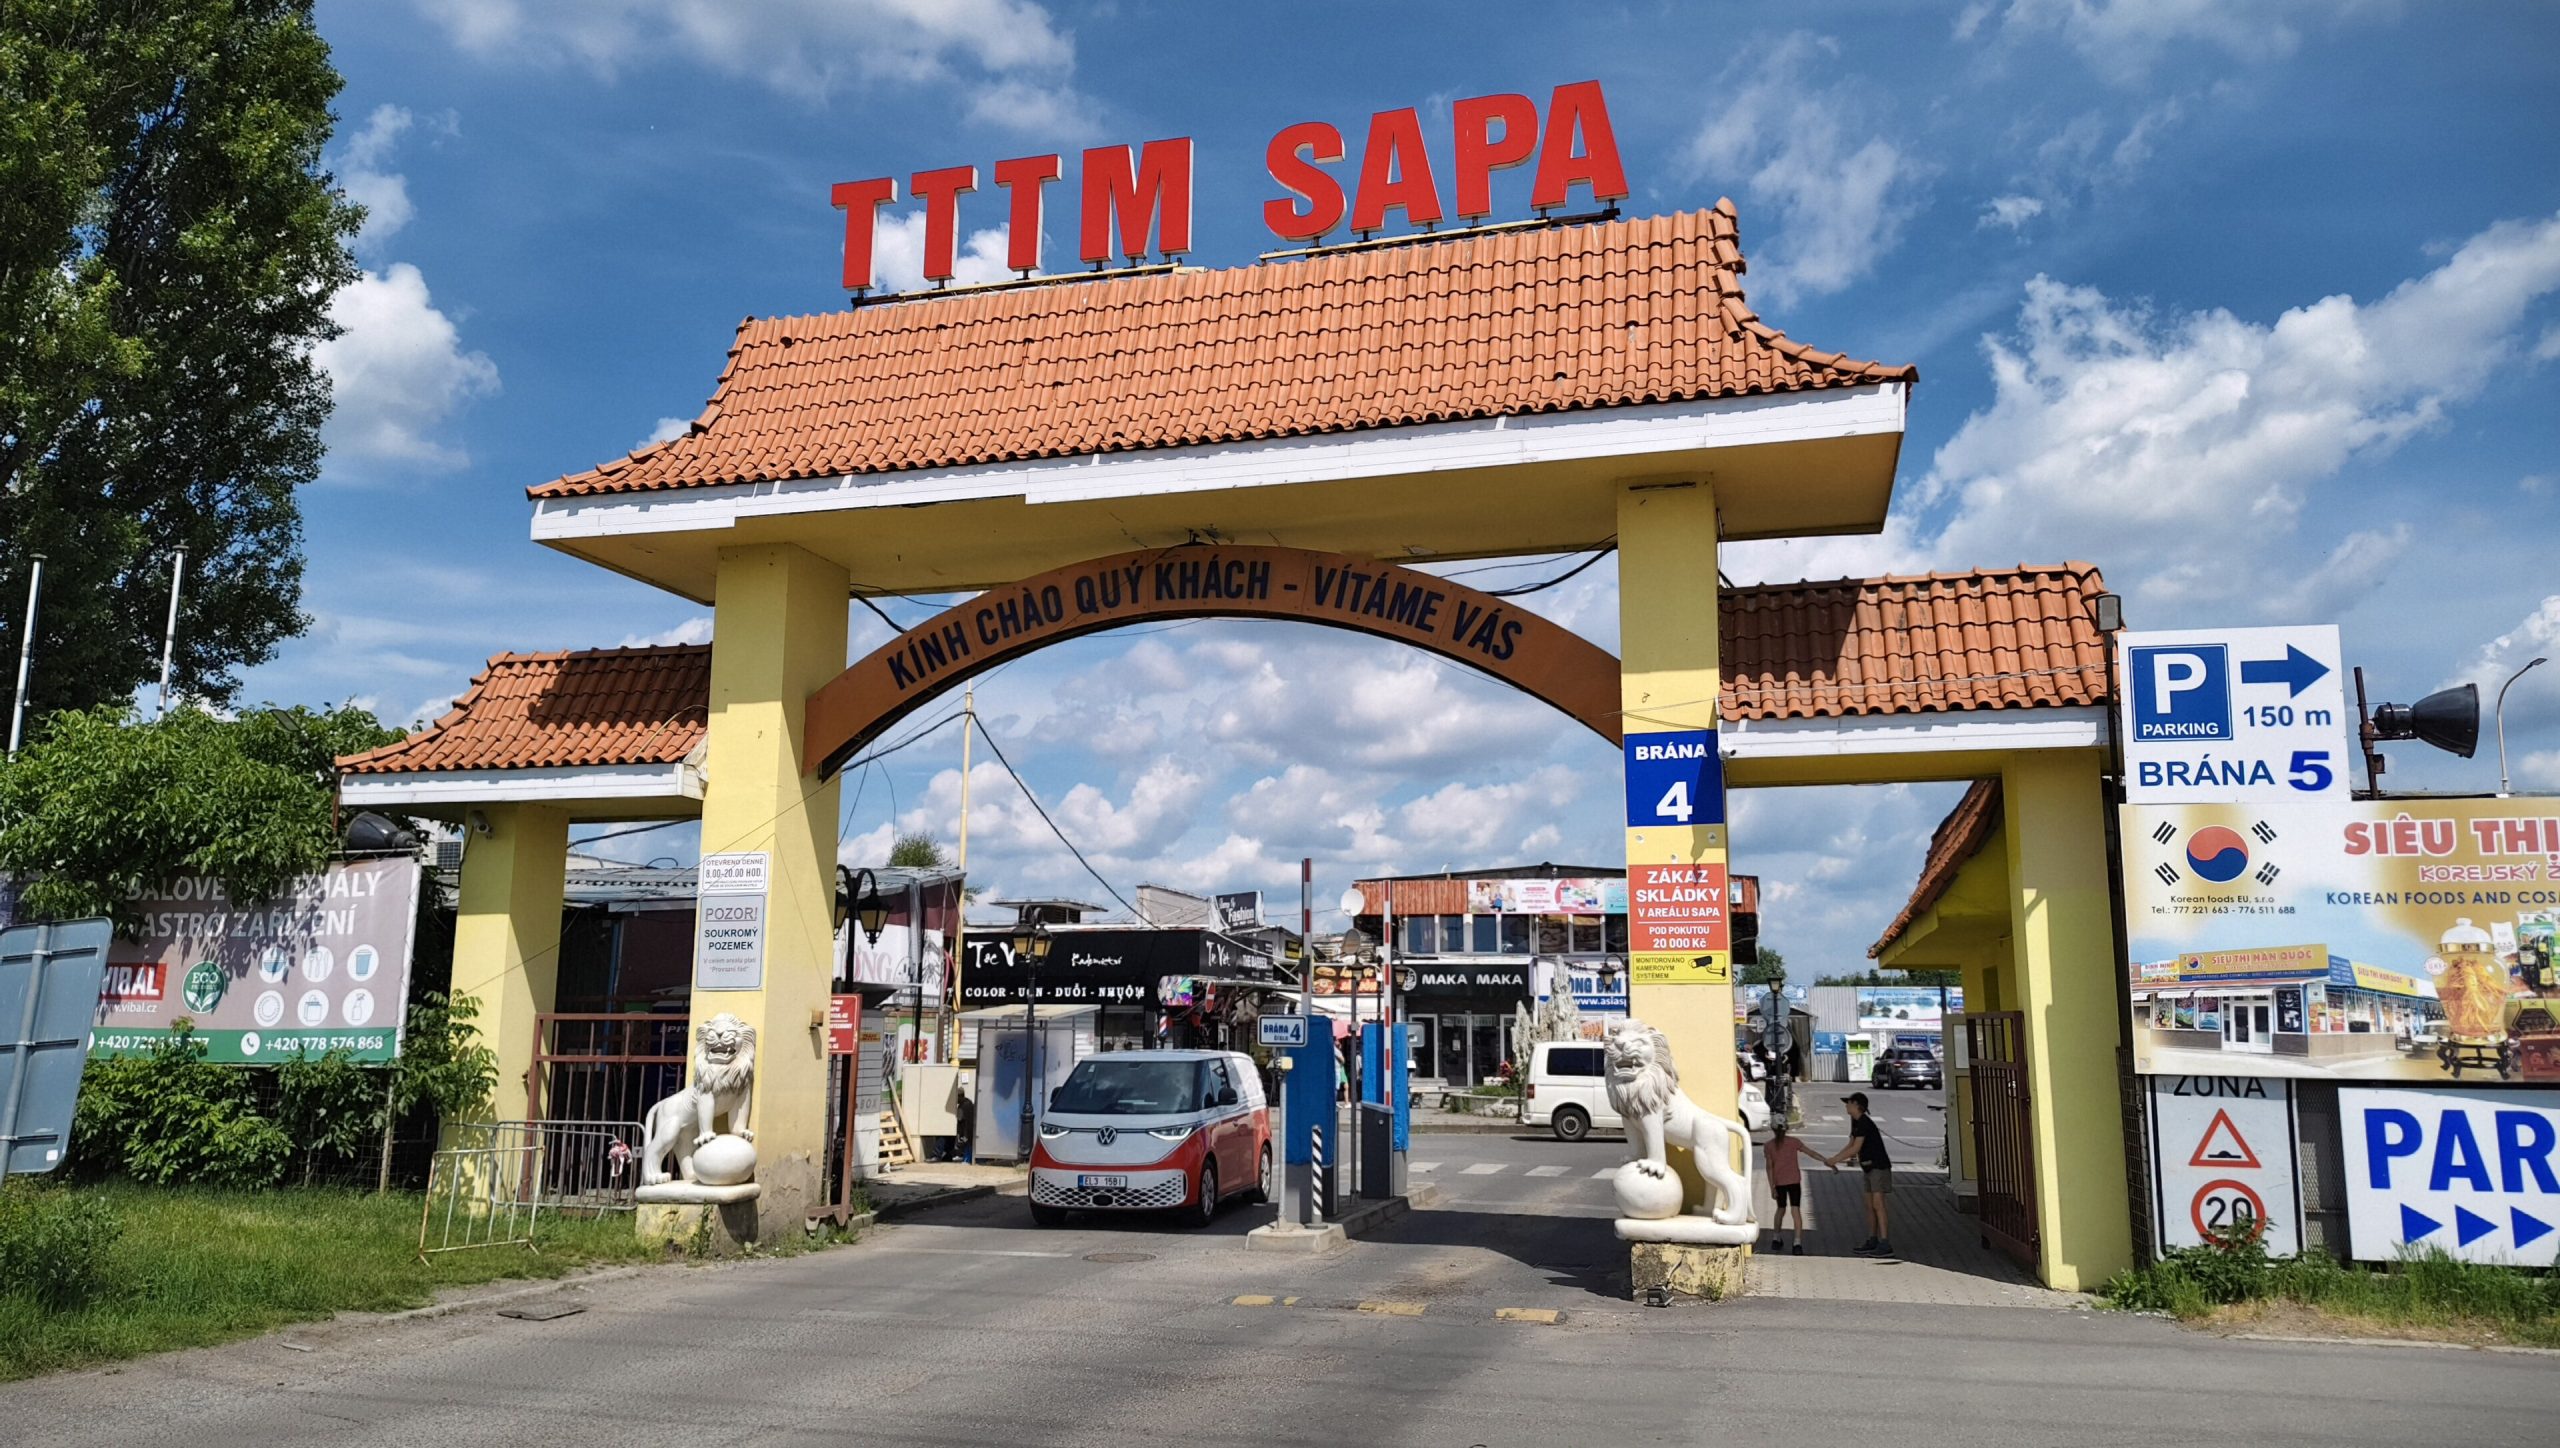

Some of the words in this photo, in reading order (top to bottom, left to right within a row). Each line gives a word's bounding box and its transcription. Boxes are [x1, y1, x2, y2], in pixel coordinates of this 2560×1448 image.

[831, 136, 1195, 291] TTTM
[1263, 79, 1630, 241] SAPA
[886, 620, 971, 690] KÍNH
[975, 584, 1065, 646] CHÀO
[1074, 560, 1145, 614] QUÝ
[1155, 554, 1271, 601] KHÁCH
[1314, 562, 1445, 633] VÍTÁME
[1451, 599, 1524, 660] VÁS
[2152, 653, 2207, 715] P
[2243, 705, 2294, 728] 150
[2305, 709, 2331, 726] m
[2142, 722, 2219, 737] PARKING
[1635, 741, 1709, 761] BRÁNA
[2139, 753, 2276, 787] BRÁNA
[2287, 750, 2333, 792] 5
[1655, 780, 1693, 822] 4
[2343, 814, 2456, 856] SIÊU
[2472, 818, 2560, 862] THỊ
[1647, 867, 1709, 884] ZÁKAZ
[2420, 862, 2539, 881] KOREJSKÝ
[1635, 885, 1721, 903] SKLÁDKY
[2170, 895, 2205, 903] Korean
[2207, 895, 2235, 903] foods
[2326, 892, 2398, 905] KOREAN
[2404, 891, 2466, 905] FOODS
[2472, 891, 2511, 904] AND
[2517, 891, 2560, 904] COS
[705, 907, 758, 921] POZOR!
[1228, 907, 1255, 922] Fashion
[1637, 908, 1645, 918] V
[1647, 905, 1691, 918] AREÁLU
[1691, 907, 1720, 917] SAPA
[2151, 906, 2171, 914] Tel.:
[2173, 906, 2190, 914] 777
[2192, 906, 2209, 914] 221
[2211, 906, 2229, 914] 663
[2238, 906, 2255, 914] 776
[2258, 906, 2275, 914] 511
[2278, 906, 2296, 914] 688
[704, 926, 758, 938] SOUKROMÝ
[1648, 926, 1667, 936] POD
[1667, 925, 1710, 935] POKUTOU
[708, 941, 754, 951] POZEMEK
[1652, 938, 1668, 948] 20
[1669, 938, 1690, 948] 000
[1692, 938, 1707, 948] Kč
[192, 972, 219, 984] ECO
[1422, 974, 1468, 985] MAKA
[1476, 974, 1523, 985] MAKA
[965, 987, 1006, 998] COLOR
[1263, 1022, 1289, 1034] BRÁNA
[1289, 1023, 1301, 1041] 4
[98, 1036, 130, 1049] +420
[265, 1037, 298, 1052] +420
[300, 1037, 327, 1052] 778
[356, 1036, 383, 1050] 868
[902, 1039, 928, 1061] AKE
[2205, 1196, 2253, 1230] 20
